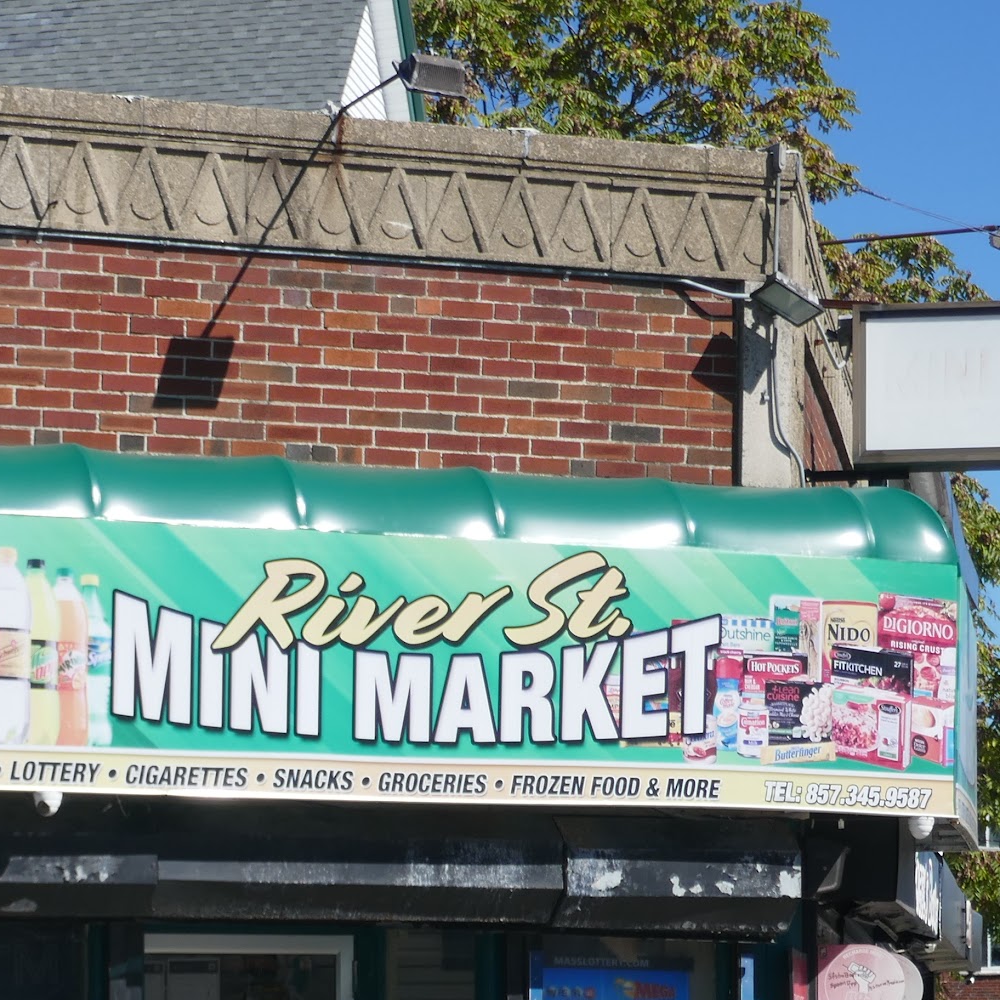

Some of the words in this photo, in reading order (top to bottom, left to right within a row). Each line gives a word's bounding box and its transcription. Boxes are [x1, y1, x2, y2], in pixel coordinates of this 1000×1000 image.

[210, 557, 513, 655] River
[503, 550, 634, 648] St.
[828, 623, 871, 642] NIDO
[890, 640, 918, 652] RISING
[919, 643, 945, 655] CRUST
[111, 588, 322, 740] MINI
[352, 613, 722, 745] MARKET
[751, 661, 767, 672] HOT
[767, 662, 800, 674] POCKETS
[775, 746, 821, 762] Butterfinger
[10, 761, 101, 783] LOTTERY
[125, 764, 249, 788] CIGARETTES
[272, 768, 354, 791] SNACKS
[378, 772, 488, 795] GROCERIES
[511, 774, 586, 796] FROZEN
[590, 777, 641, 797] FOOD
[645, 778, 661, 798] &
[666, 778, 722, 799] MORE
[764, 781, 802, 804] TEL:
[805, 783, 933, 809] 857.345.9587
